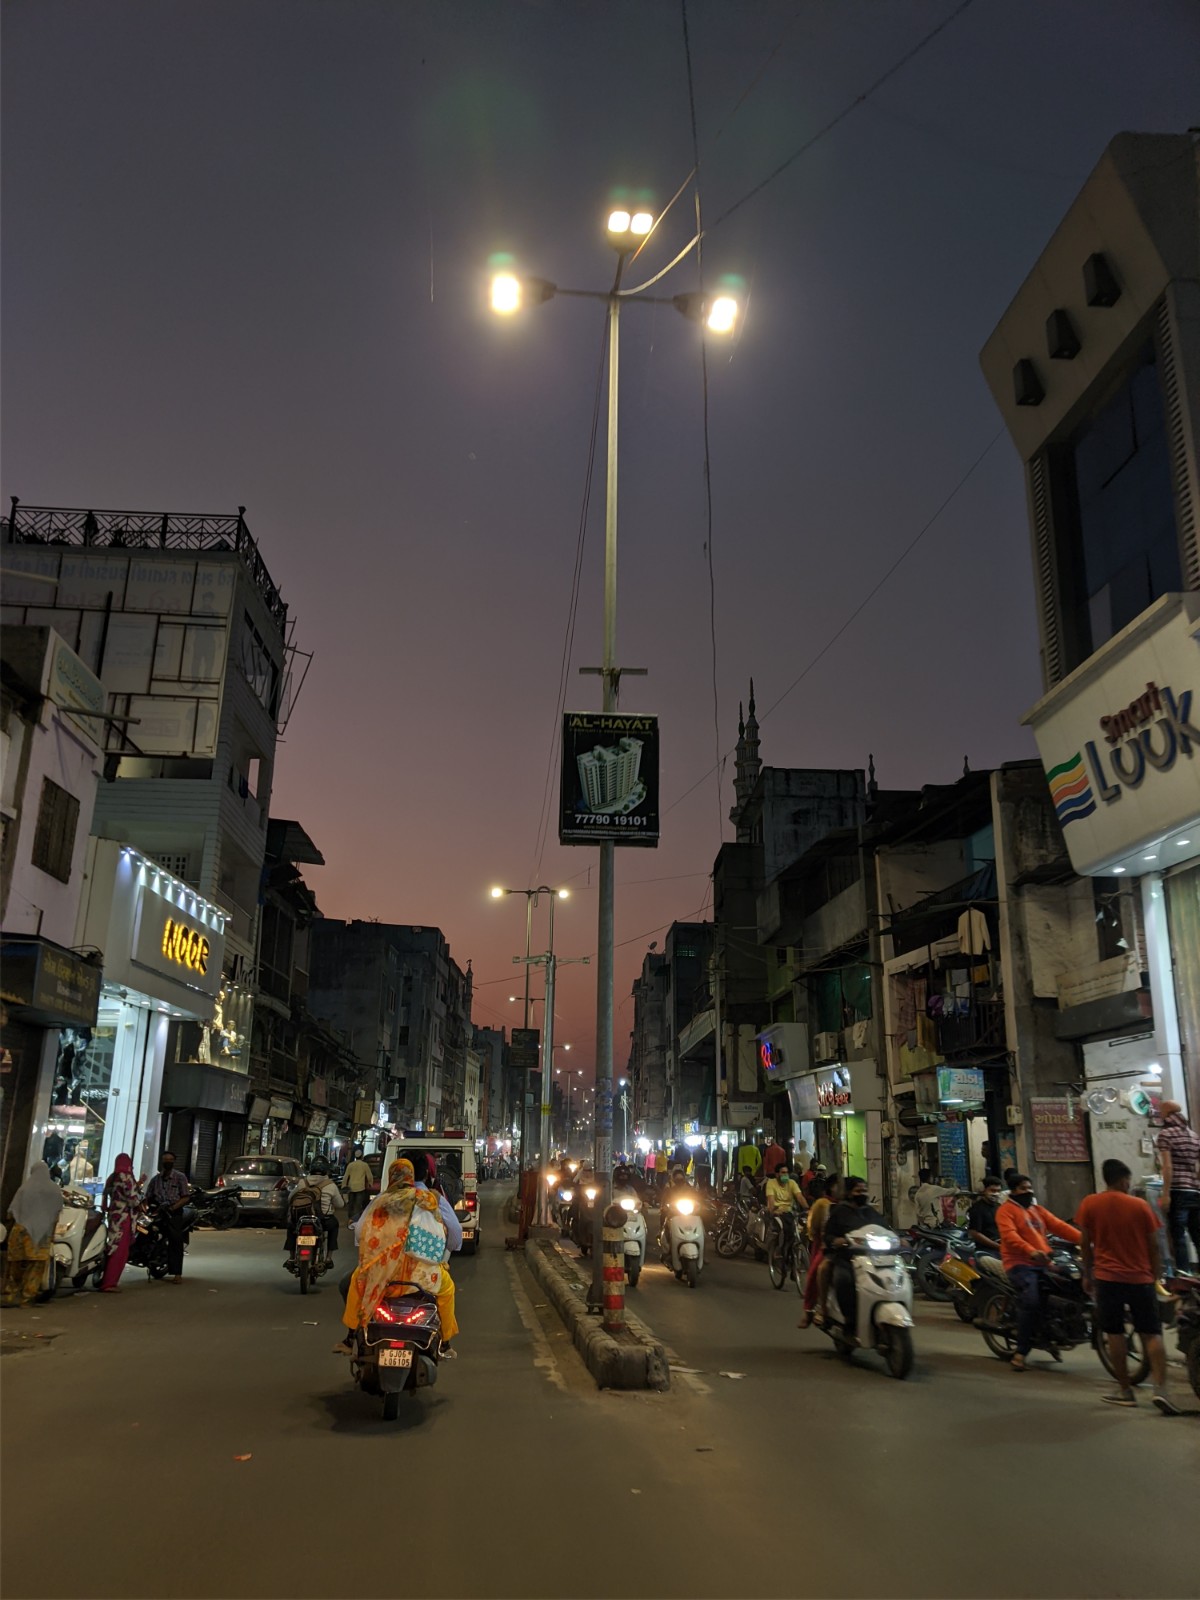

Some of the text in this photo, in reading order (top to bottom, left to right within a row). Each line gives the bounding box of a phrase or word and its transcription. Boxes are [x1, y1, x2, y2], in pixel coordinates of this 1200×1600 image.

[1100, 681, 1163, 746] Smart
[571, 716, 653, 730] AL-HAYAT
[574, 814, 648, 825] 77790 19101
[162, 917, 210, 977] NOOR
[1034, 1110, 1081, 1124] ઓમકર
